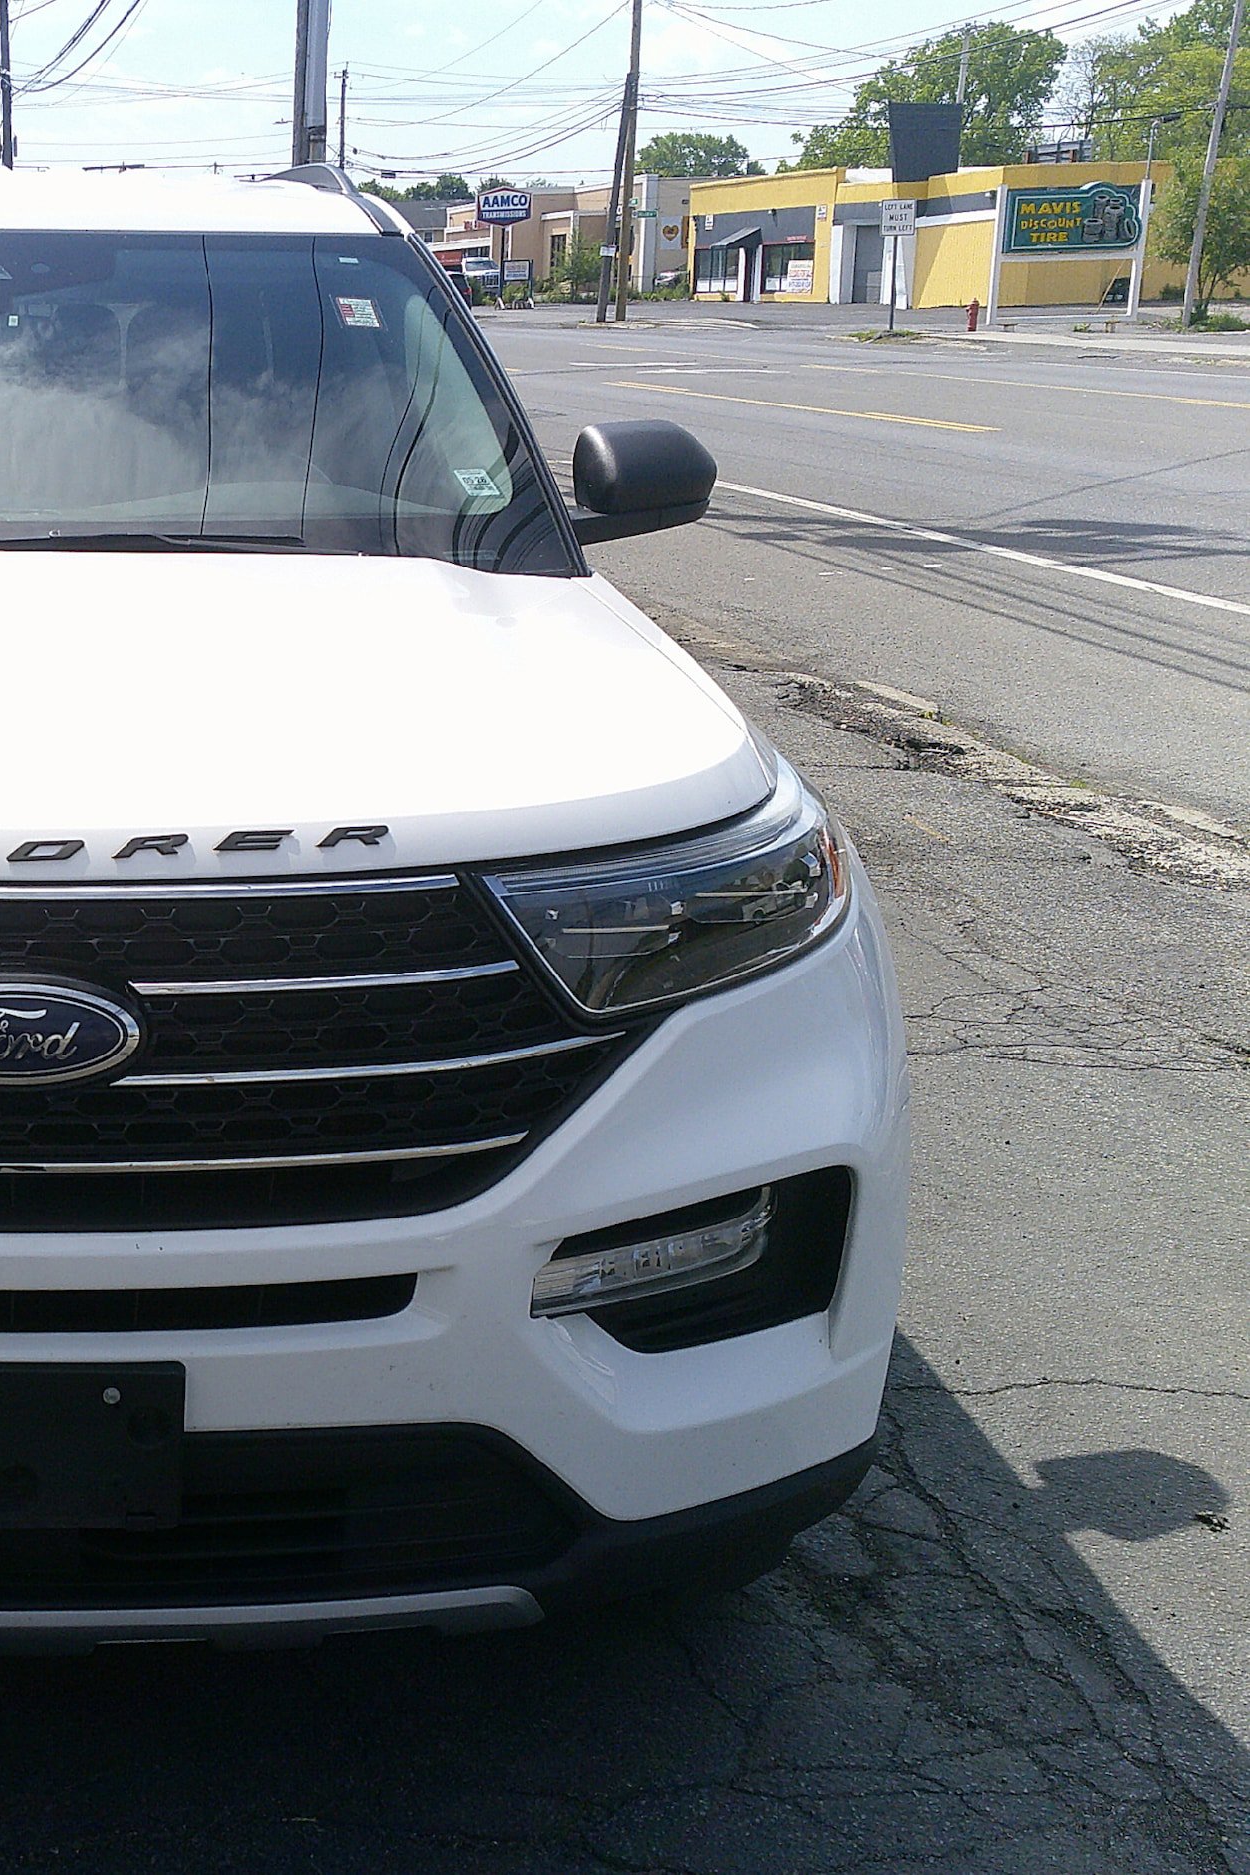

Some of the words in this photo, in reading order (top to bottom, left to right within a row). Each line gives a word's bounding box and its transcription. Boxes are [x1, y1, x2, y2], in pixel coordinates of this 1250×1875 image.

[482, 194, 528, 208] AAMCO
[884, 203, 897, 211] LEFT
[1020, 201, 1082, 215] MAVIS
[482, 210, 527, 219] TRANSMISSIONS
[888, 213, 908, 222] MUST
[1020, 217, 1083, 230] DISCOUNT
[1030, 231, 1069, 243] TIRE
